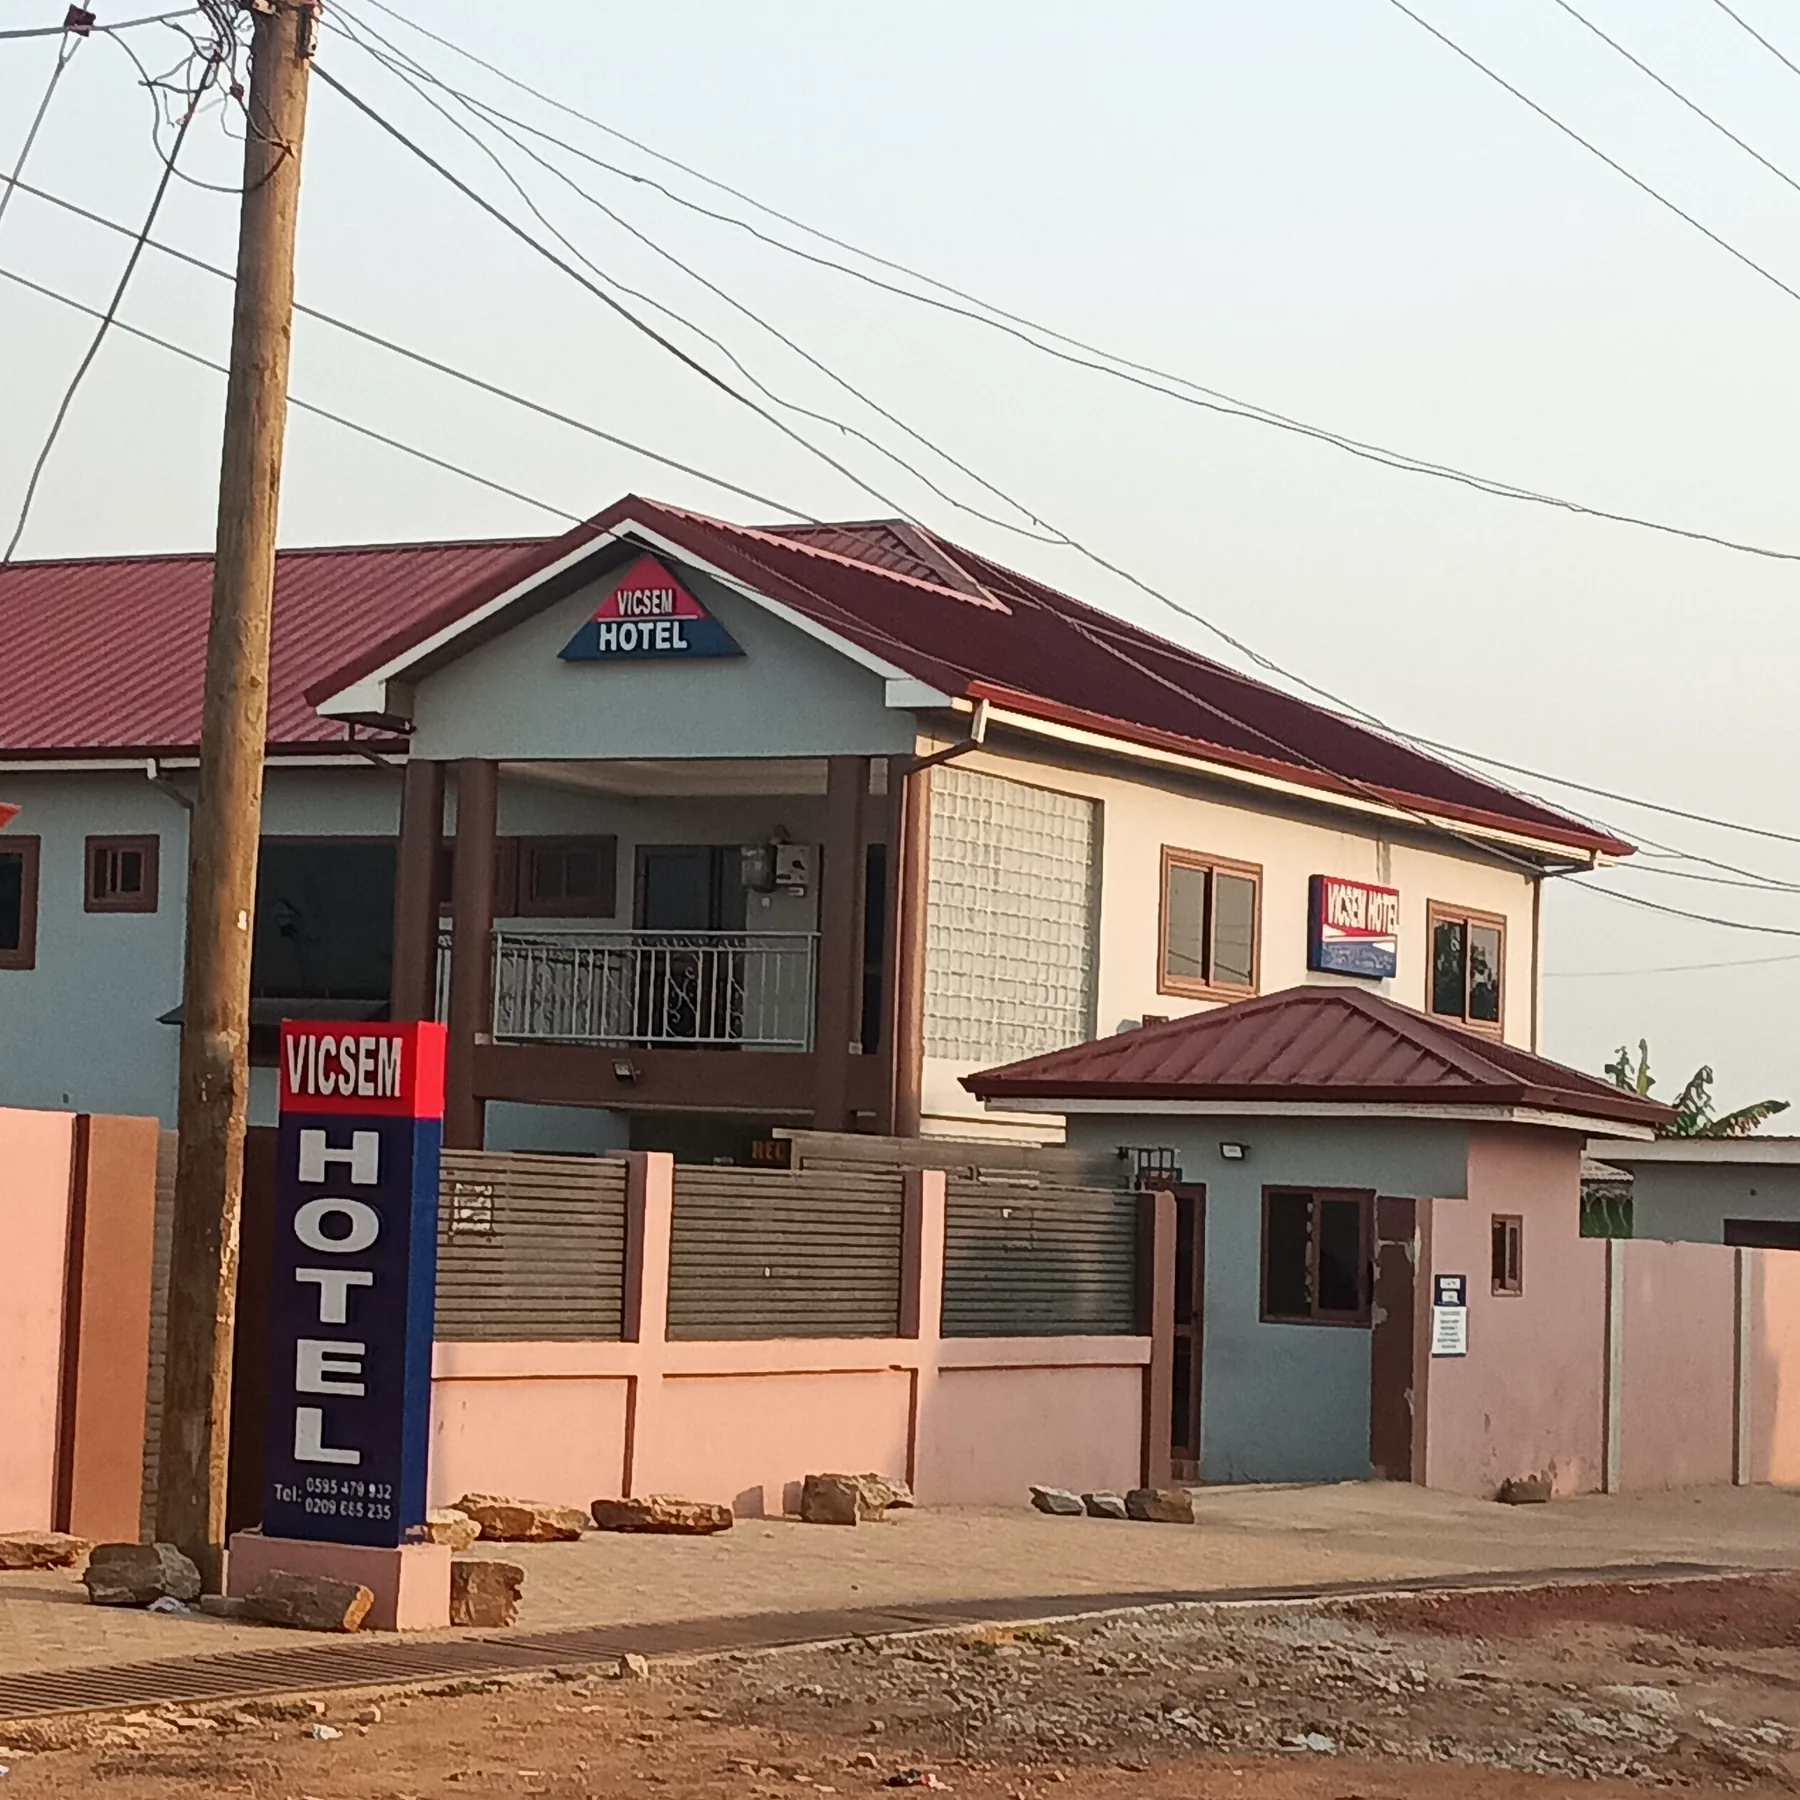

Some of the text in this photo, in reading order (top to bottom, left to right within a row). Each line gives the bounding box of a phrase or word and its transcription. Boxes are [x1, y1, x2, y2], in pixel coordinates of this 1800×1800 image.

[617, 589, 673, 615] VICSEM
[599, 621, 688, 651] HOTEL
[286, 1034, 403, 1097] VICSEM
[294, 1129, 379, 1465] HOTEL
[273, 1483, 302, 1502] Tel:
[306, 1477, 337, 1494] 0595
[367, 1502, 392, 1520] 235
